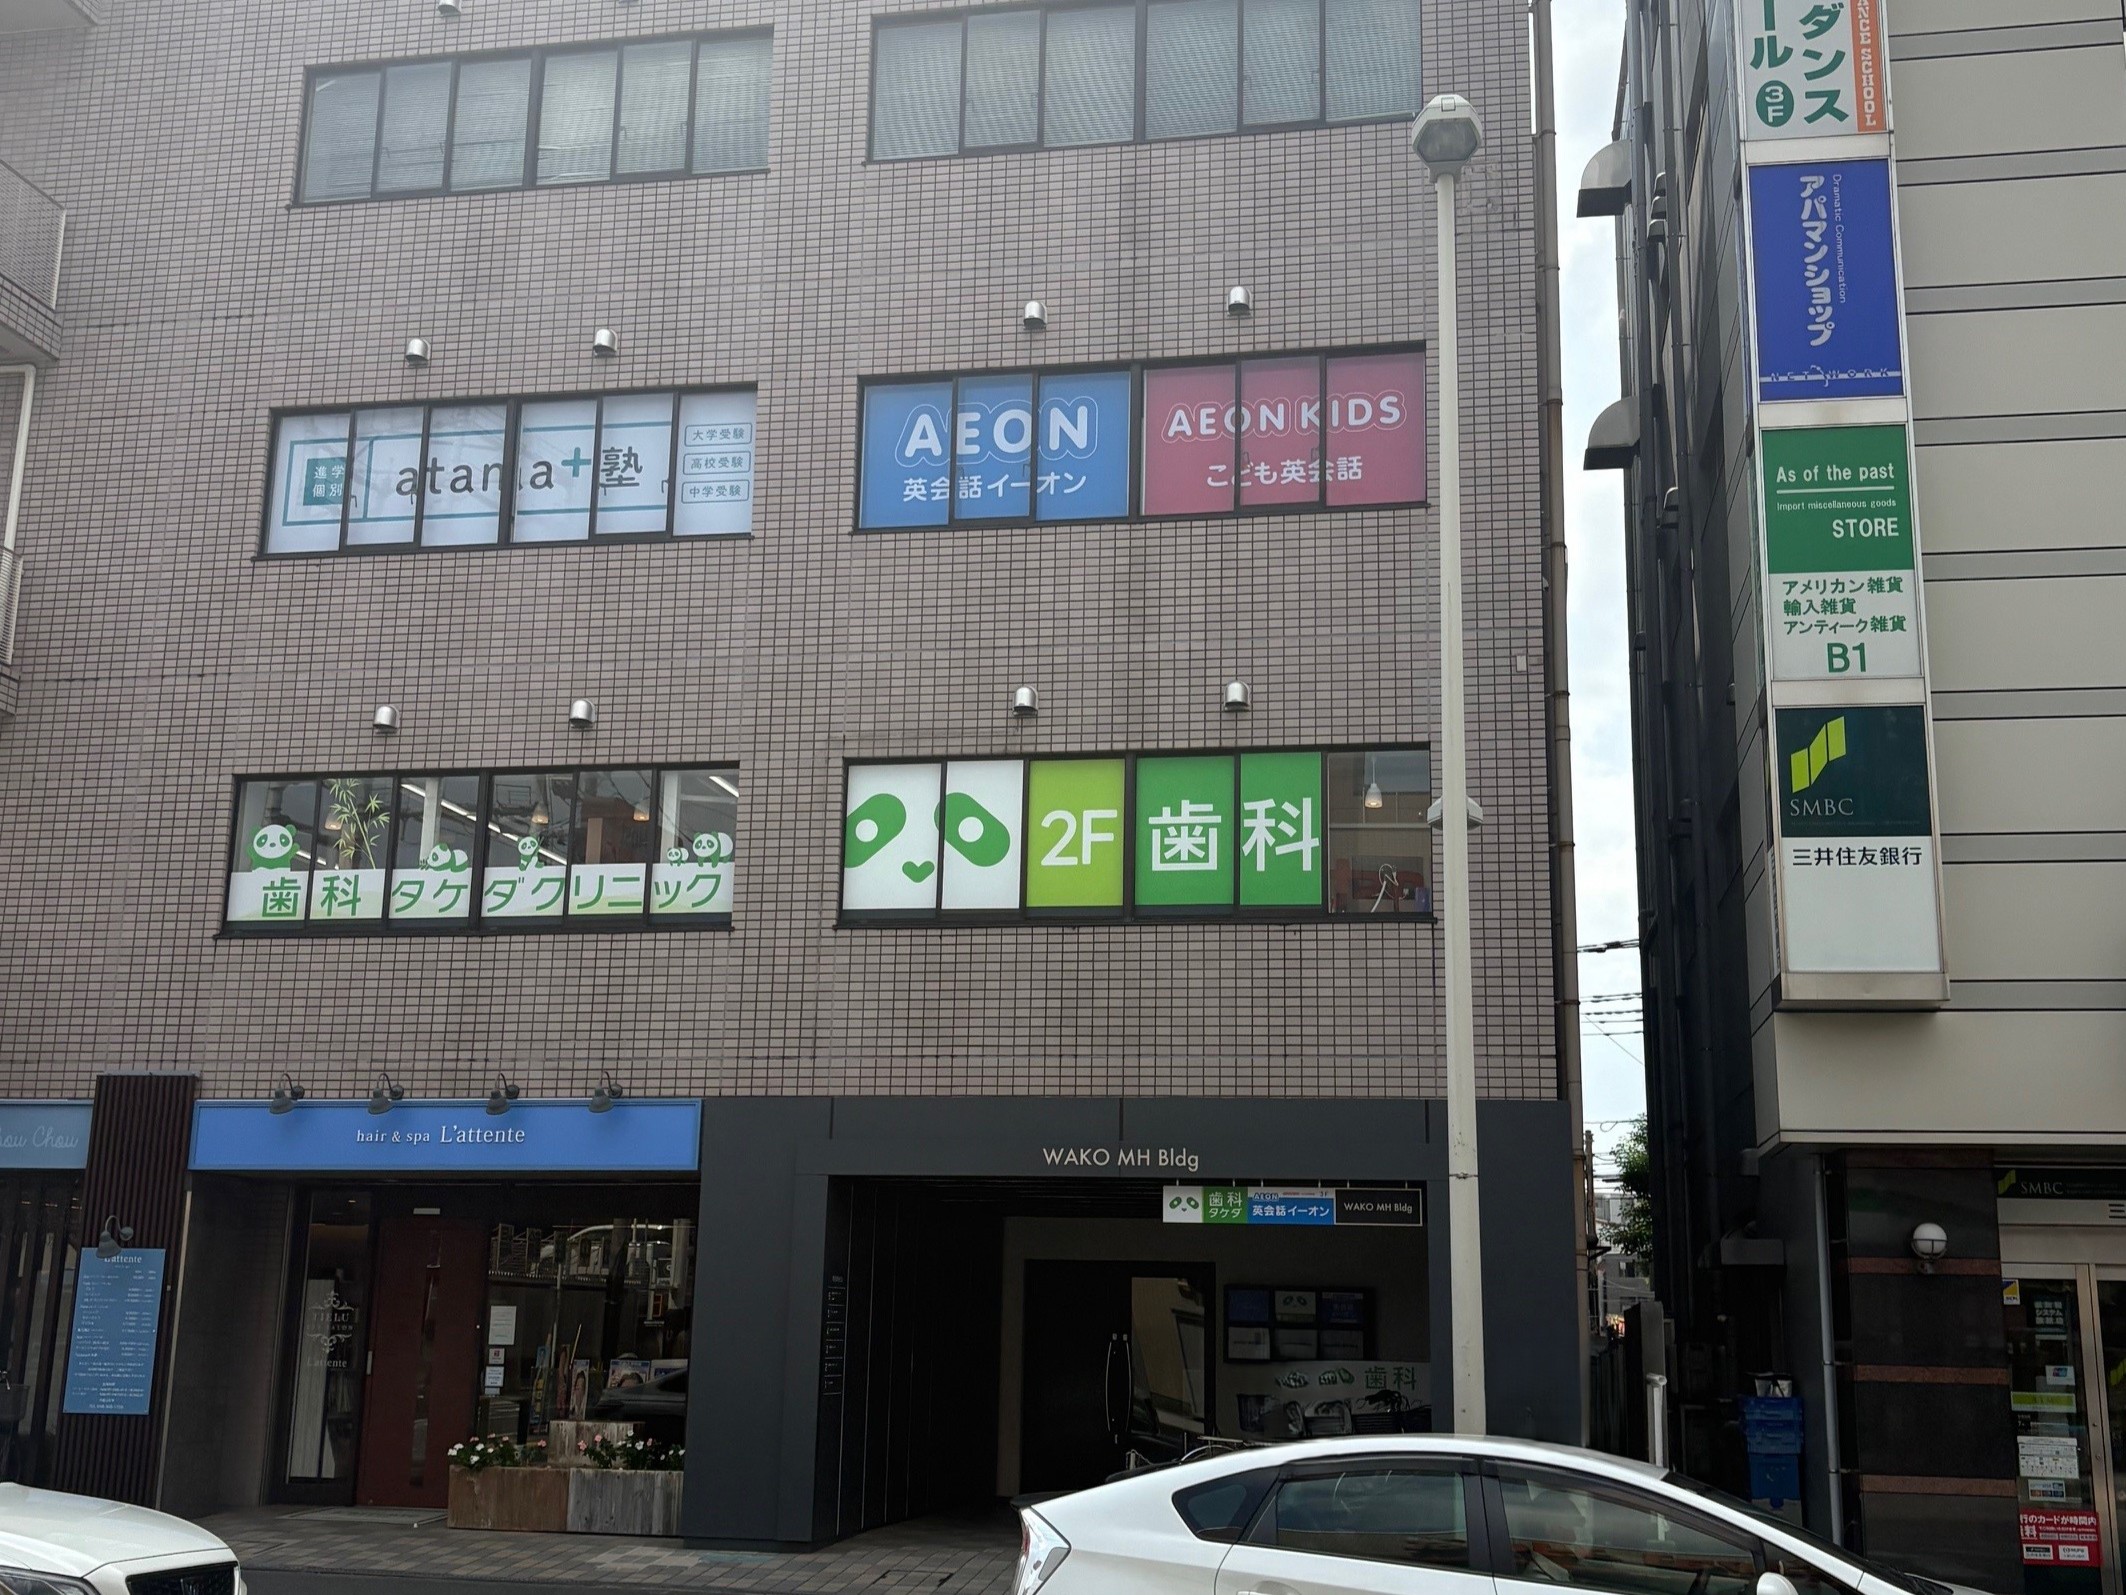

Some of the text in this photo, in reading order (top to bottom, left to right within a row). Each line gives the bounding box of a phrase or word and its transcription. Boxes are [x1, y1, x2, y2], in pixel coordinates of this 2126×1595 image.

[1799, 2, 1849, 124] ダンス
[1860, 48, 1876, 126] SCHOOL
[1765, 86, 1784, 123] 3F
[1832, 174, 1846, 303] Dramatic Communication
[1799, 175, 1835, 347] アパマンショップ
[1167, 395, 1401, 438] AEON KIDS
[691, 428, 745, 442] 大学受験
[904, 405, 1089, 458] AEON
[314, 465, 344, 479] 進学
[690, 456, 744, 471] 高校受験
[1207, 456, 1363, 488] こども英会話
[1776, 463, 1895, 483] As of the past
[312, 483, 343, 498] 個別
[689, 484, 742, 499] 中学受験
[1776, 499, 1897, 511] Import miscellaneous goods
[1832, 517, 1899, 539] STORE
[1783, 577, 1903, 596] アメリカン雑貨
[1783, 597, 1856, 616] 輸入雑貨
[1784, 616, 1907, 635] アンティーク雑貨
[1827, 642, 1869, 674] B1
[1790, 798, 1854, 817] SMBC
[1040, 796, 1319, 872] 2F 歯科
[1793, 846, 1922, 866] 三井住友銀行
[32, 1126, 78, 1149] Chou
[356, 1125, 525, 1145] hair & spa L'attente
[1043, 1148, 1199, 1172] WAKO MH Bldg
[2020, 1181, 2063, 1195] SMBC
[1208, 1192, 1242, 1207] 歯科
[1344, 1202, 1412, 1214] WAKO MH Bldg
[1208, 1207, 1242, 1219] タケダ
[1252, 1205, 1330, 1217] 英会話イーオン
[1364, 1367, 1417, 1391] 歯科
